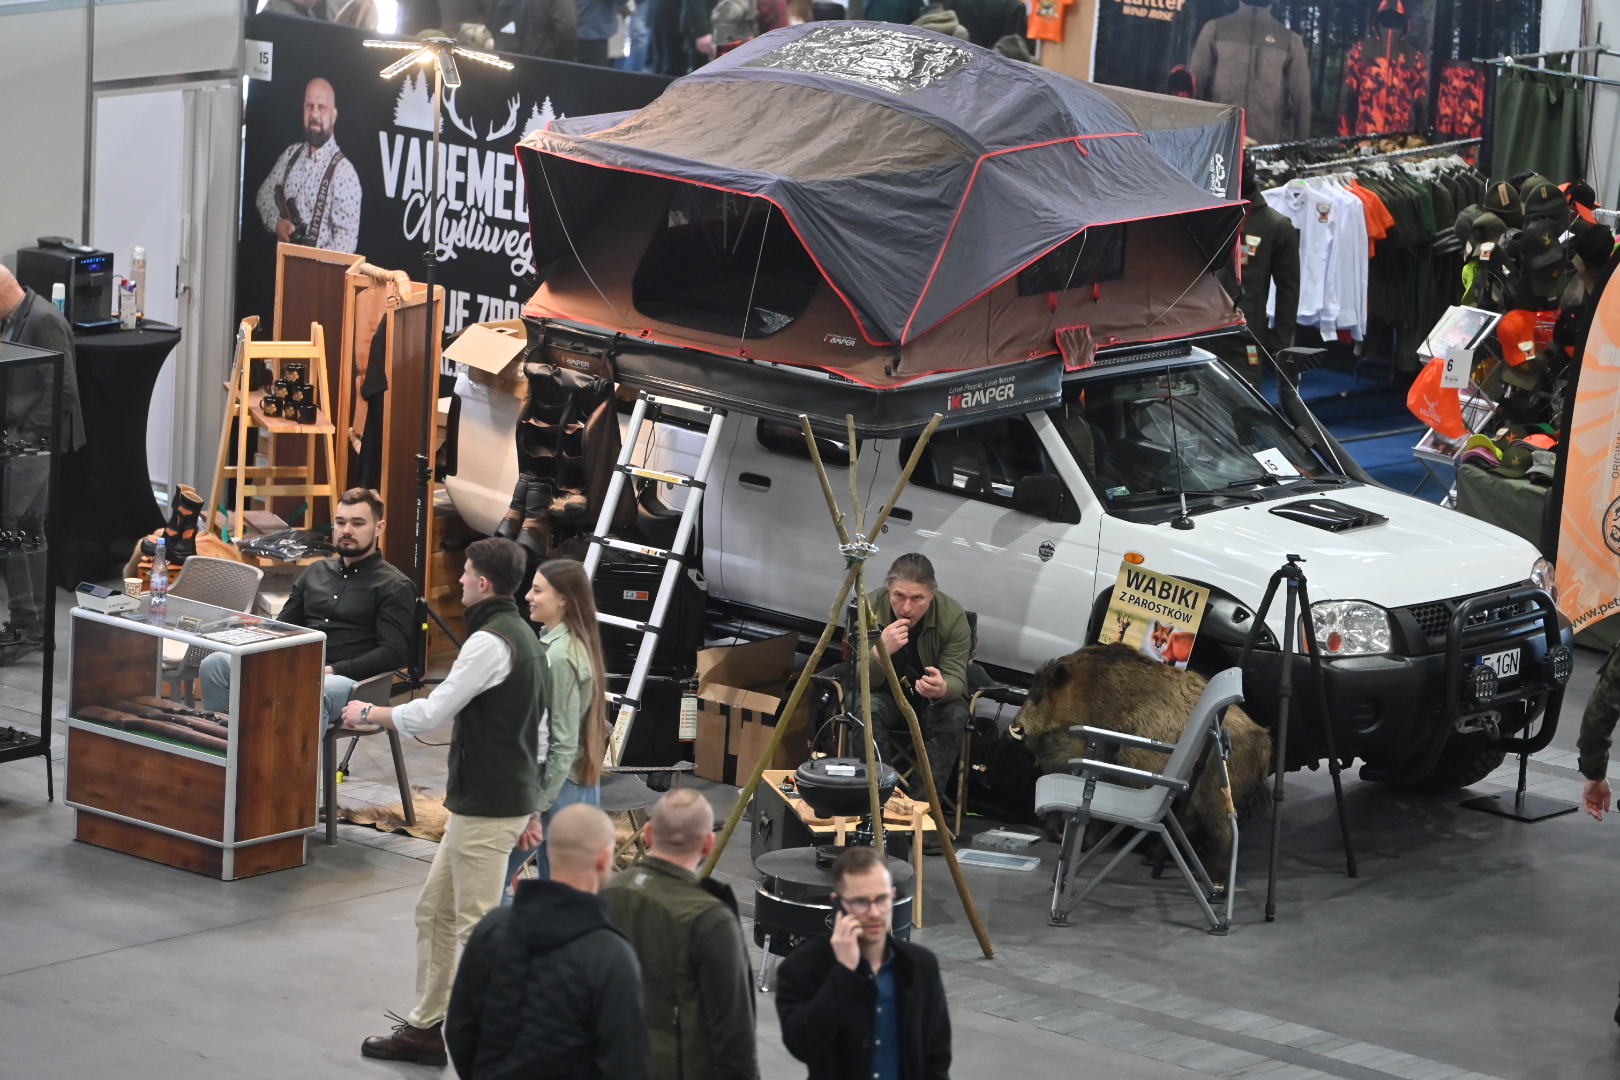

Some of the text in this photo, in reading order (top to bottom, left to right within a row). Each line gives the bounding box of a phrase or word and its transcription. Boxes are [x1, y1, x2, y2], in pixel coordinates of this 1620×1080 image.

[259, 51, 269, 65] 15
[310, 178, 329, 241] CHEVALIER
[1446, 358, 1454, 372] 6
[948, 386, 964, 394] Love
[984, 379, 998, 388] Love
[1264, 459, 1279, 471] 15
[1126, 569, 1200, 610] WABIKI
[1119, 591, 1193, 624] Z PAROSTKÓW
[1571, 597, 1620, 628] www.pet
